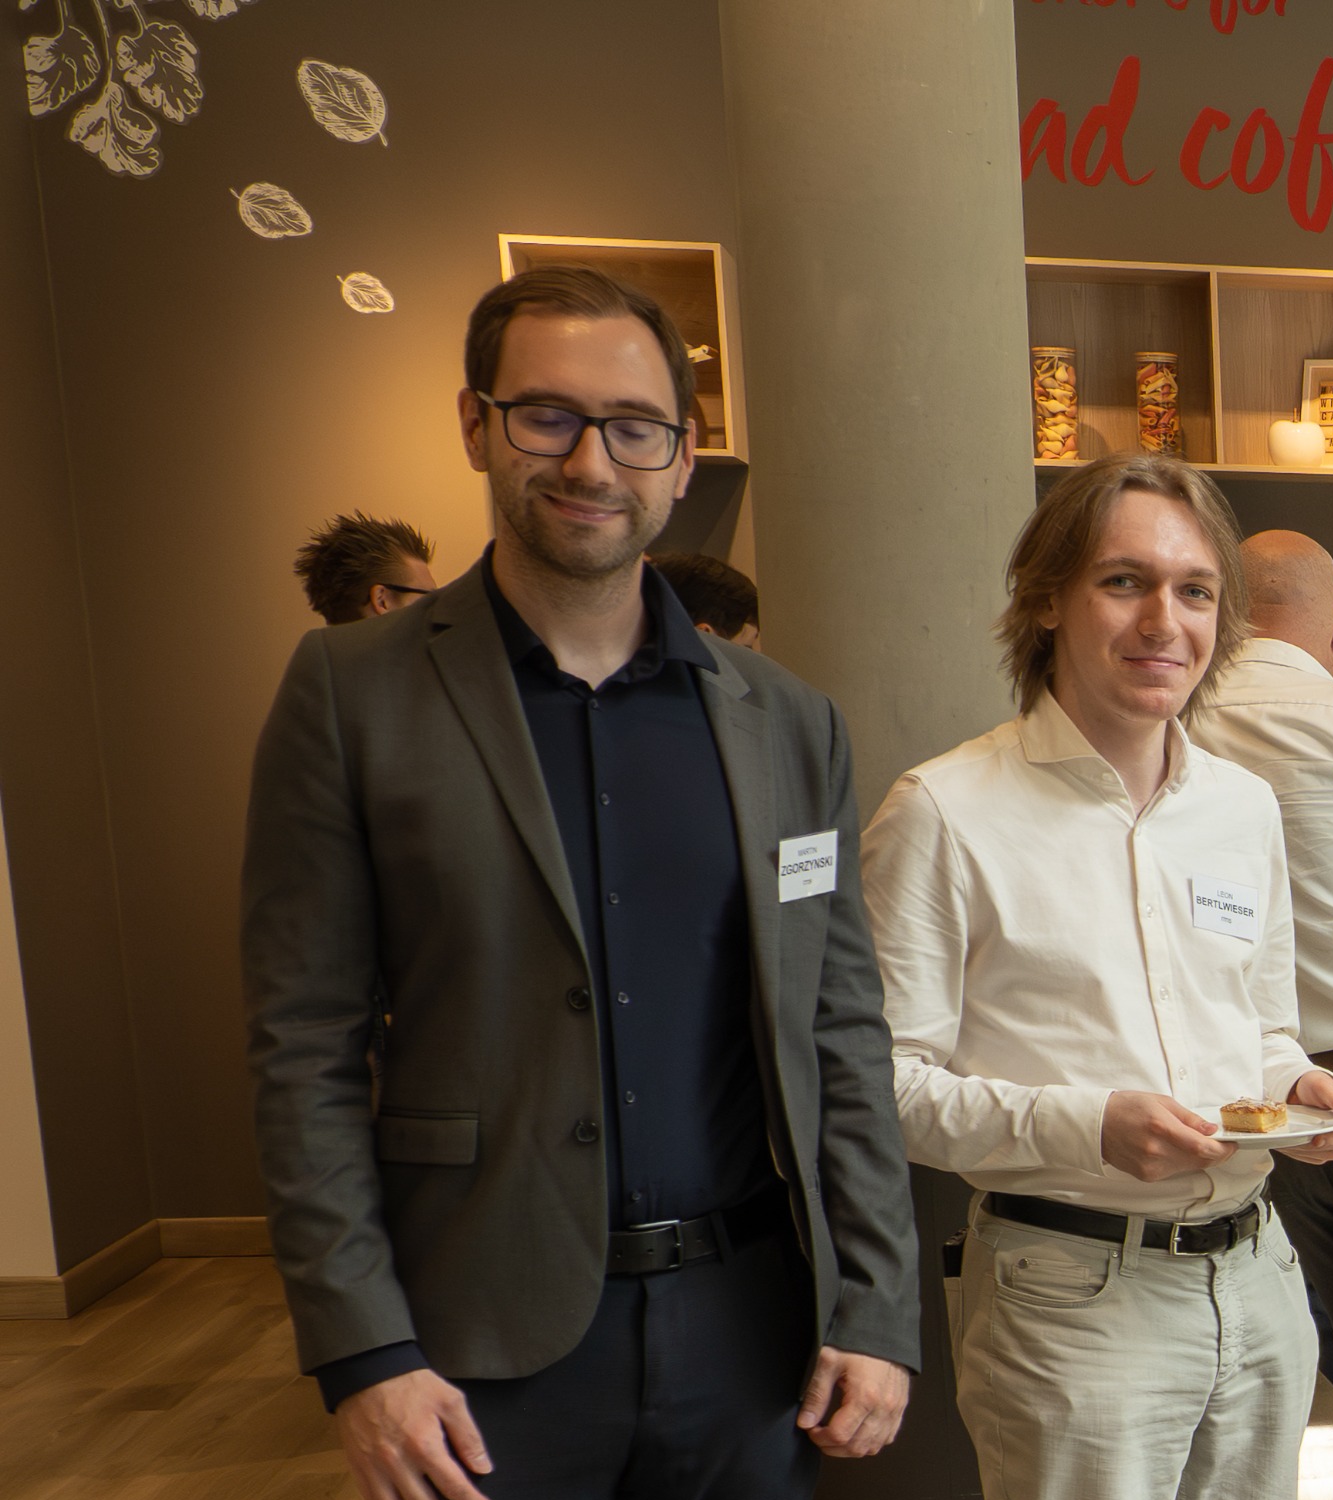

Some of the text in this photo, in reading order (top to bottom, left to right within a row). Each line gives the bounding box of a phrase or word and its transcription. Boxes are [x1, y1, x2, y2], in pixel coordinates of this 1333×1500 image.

[1021, 56, 1156, 187] ad
[781, 856, 833, 876] ZGORZYNSKI
[1217, 890, 1233, 899] LEON
[1196, 895, 1254, 917] BERTLWIESER
